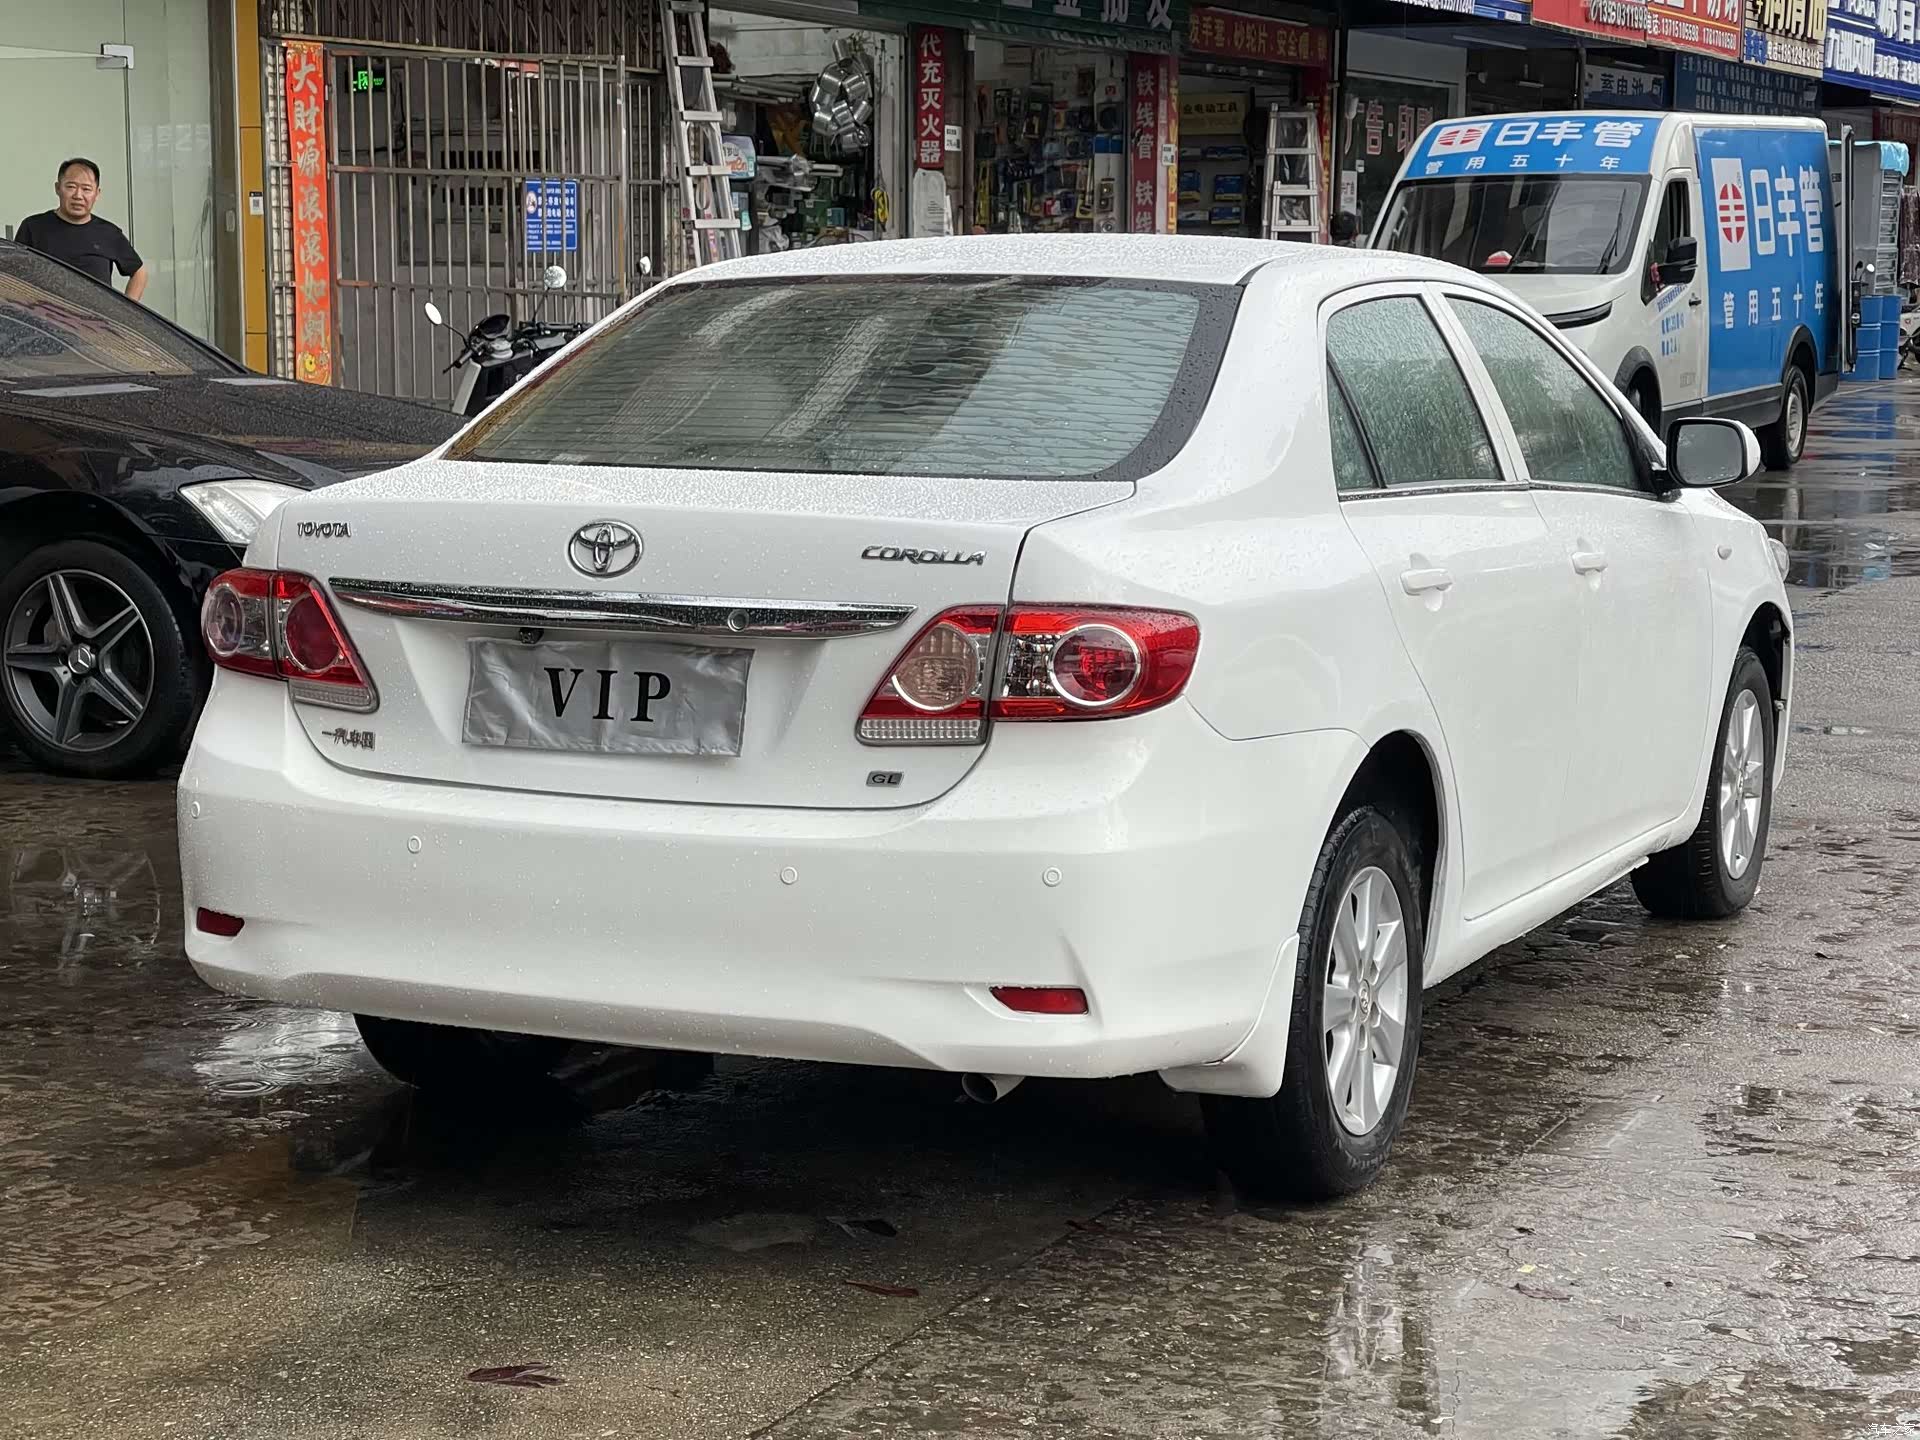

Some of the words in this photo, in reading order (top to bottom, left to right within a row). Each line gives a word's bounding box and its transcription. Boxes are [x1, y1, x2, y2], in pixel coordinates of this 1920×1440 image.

[920, 33, 942, 164] 代充灭火器
[1136, 71, 1155, 160] 铁线管
[1494, 120, 1644, 149] 日丰管
[1425, 153, 1621, 175] 管用五十年
[1750, 164, 1824, 257] 日丰管
[1723, 280, 1824, 329] 管用五十年
[297, 521, 351, 538] TOYOTA
[861, 545, 987, 566] COROLLA
[543, 667, 671, 722] VIP
[871, 773, 899, 786] GL
